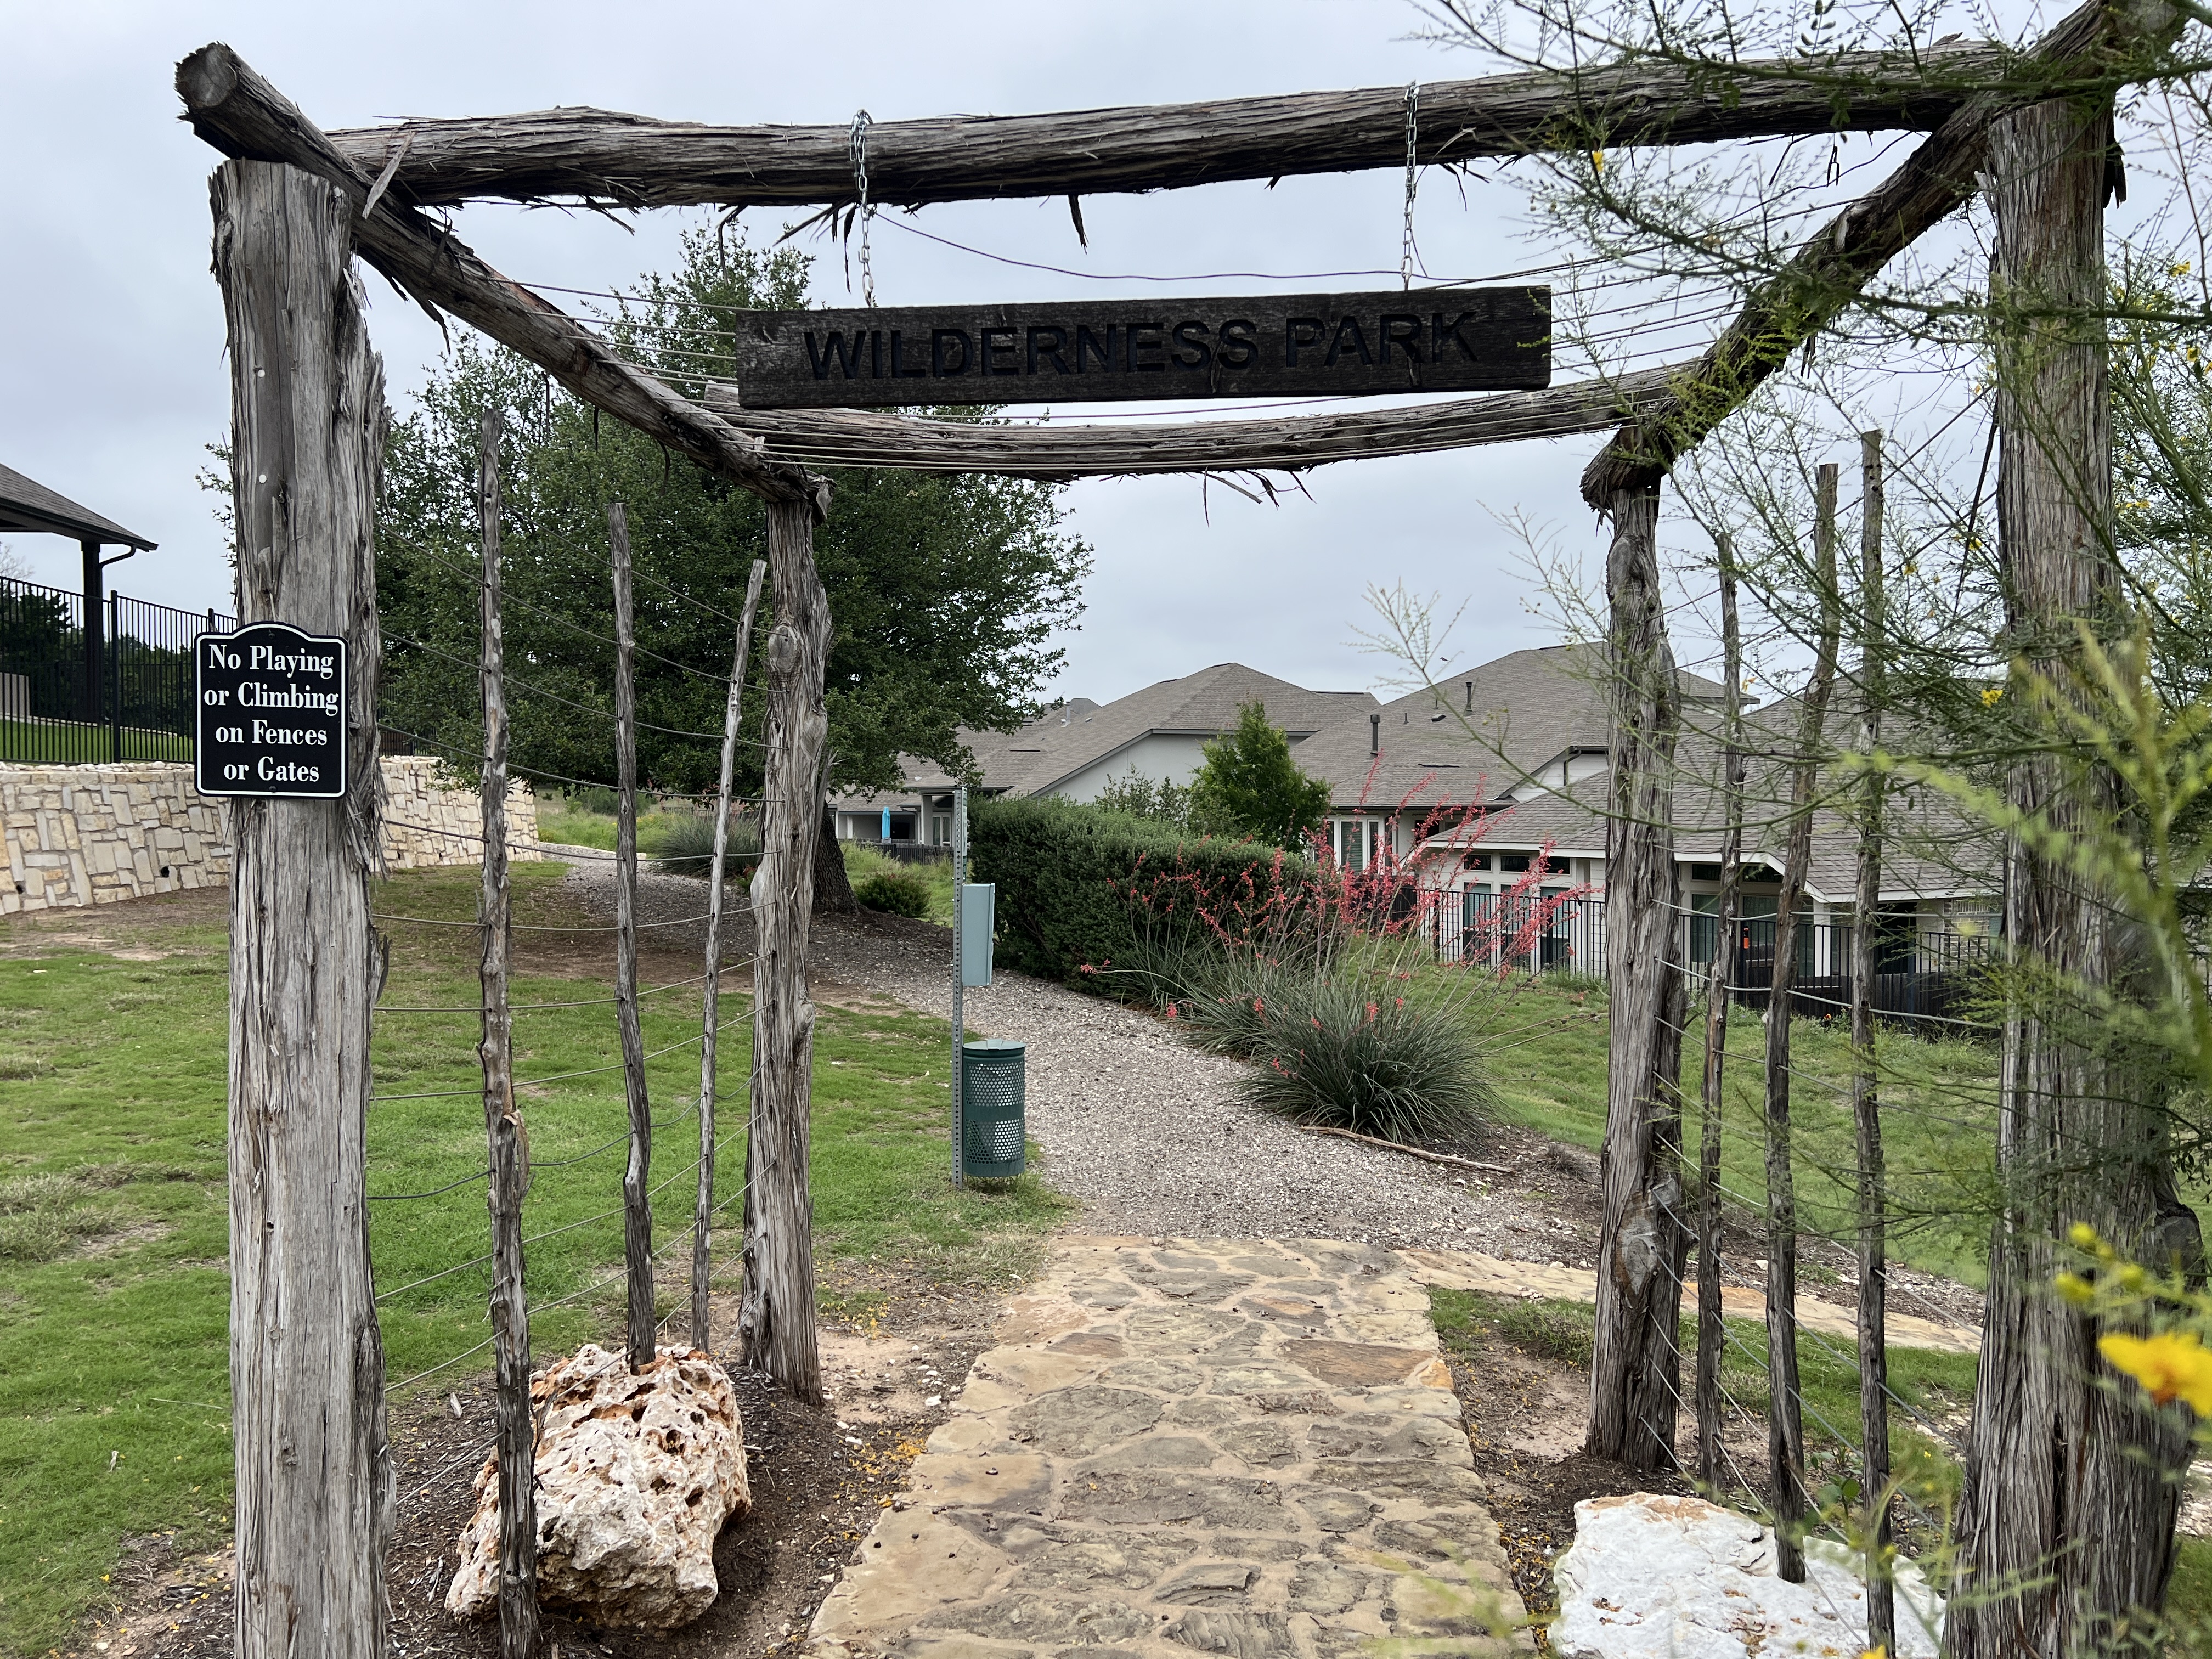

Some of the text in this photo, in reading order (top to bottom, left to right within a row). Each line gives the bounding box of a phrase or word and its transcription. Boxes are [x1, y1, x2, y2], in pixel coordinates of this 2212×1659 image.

[804, 311, 1479, 380] WILDERNESS PARK
[208, 644, 334, 679] No Playing
[204, 682, 338, 716] or Climbing
[215, 719, 328, 745] on Fences
[223, 756, 319, 782] or Gates
